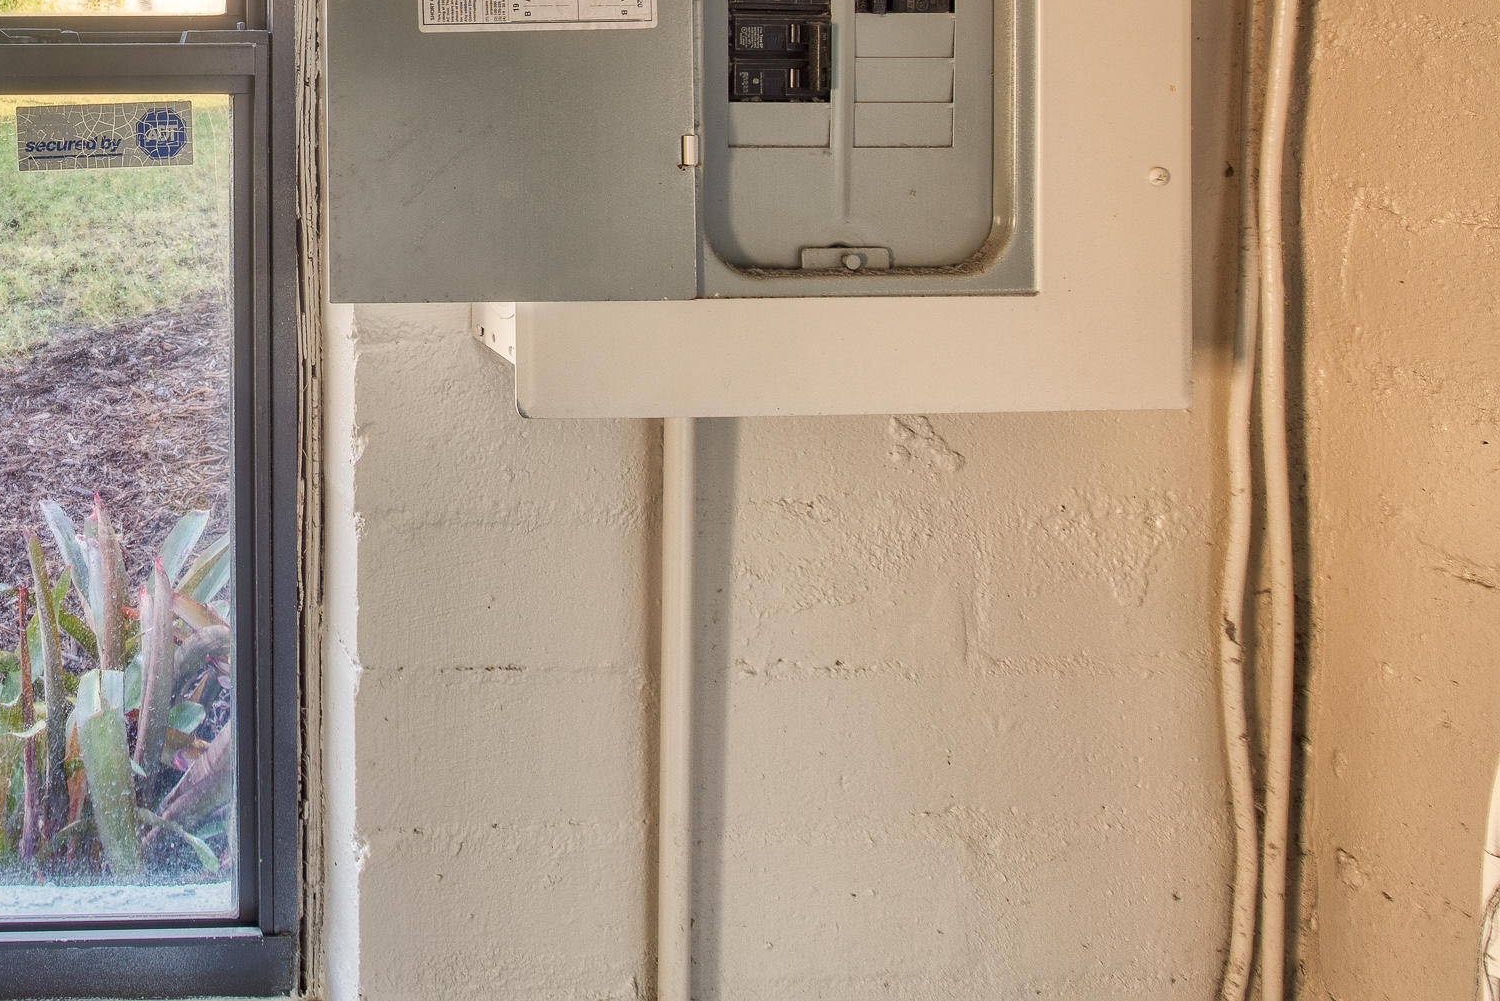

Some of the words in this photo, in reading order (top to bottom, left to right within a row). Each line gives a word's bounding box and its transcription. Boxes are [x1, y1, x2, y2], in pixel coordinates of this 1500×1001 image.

[513, 3, 519, 11] 19
[637, 0, 643, 8] 20
[25, 136, 98, 153] secured
[101, 136, 122, 153] by
